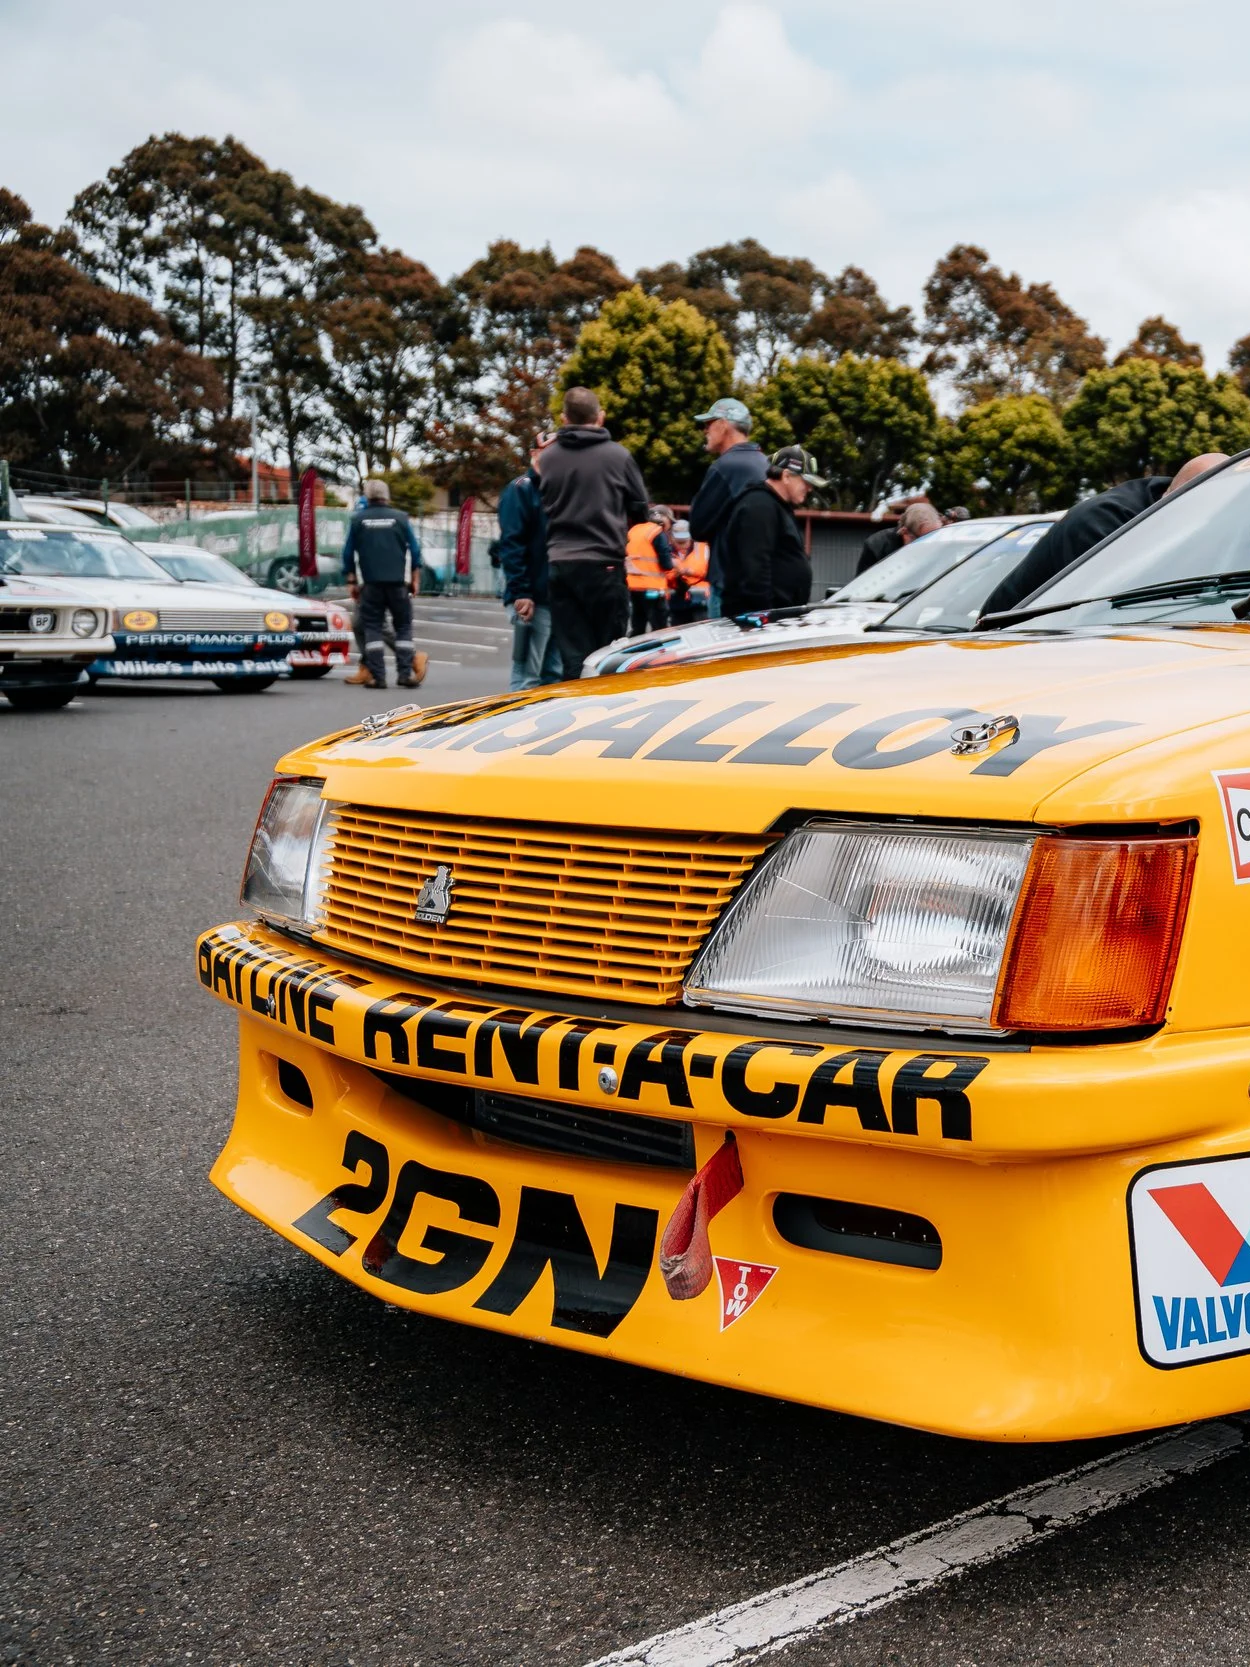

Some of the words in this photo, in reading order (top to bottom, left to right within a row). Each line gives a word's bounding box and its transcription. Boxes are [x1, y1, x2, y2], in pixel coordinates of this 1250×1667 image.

[35, 616, 49, 627] BP
[258, 634, 296, 645] PLUS
[113, 660, 182, 675] Mike's
[192, 660, 237, 674] Auto
[243, 659, 289, 674] Parts
[415, 912, 445, 924] HOLDEN
[363, 992, 990, 1141] RENT-A-CAR
[291, 1129, 660, 1339] 2GN
[726, 1265, 752, 1317] TOW
